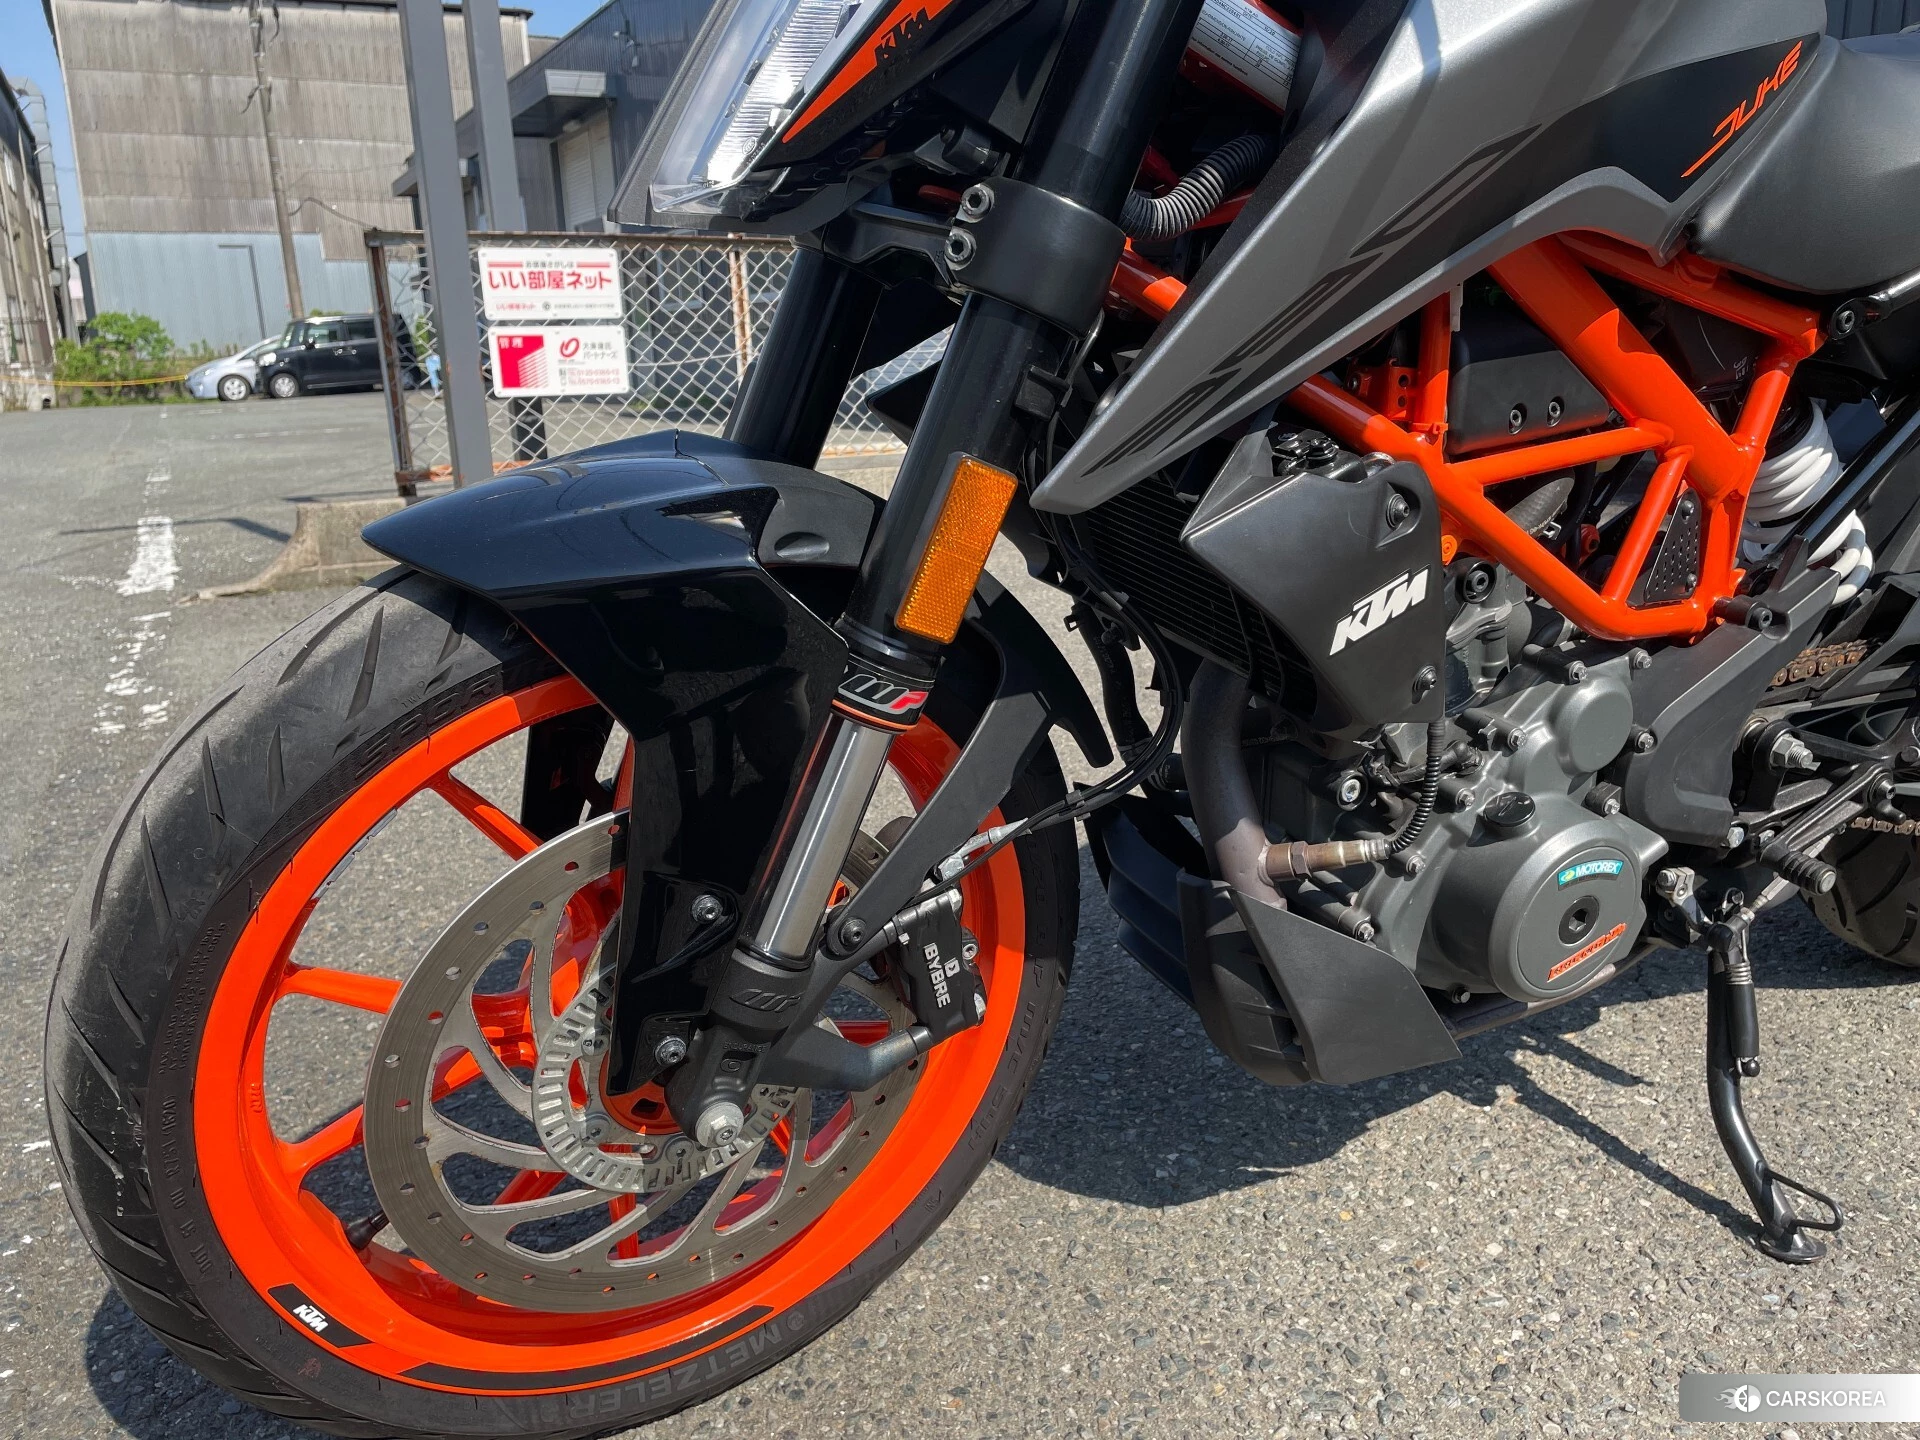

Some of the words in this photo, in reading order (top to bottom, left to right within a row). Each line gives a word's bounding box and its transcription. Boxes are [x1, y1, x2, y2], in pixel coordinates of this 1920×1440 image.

[873, 7, 931, 67] KTM
[1680, 40, 1803, 178] DUKE
[488, 270, 612, 290] いい部屋ネット
[1329, 567, 1429, 656] KTM
[1575, 861, 1620, 879] MOTOREX
[923, 942, 952, 1008] BYBRE
[292, 1303, 329, 1333] KTM
[569, 1322, 783, 1420] METZELER
